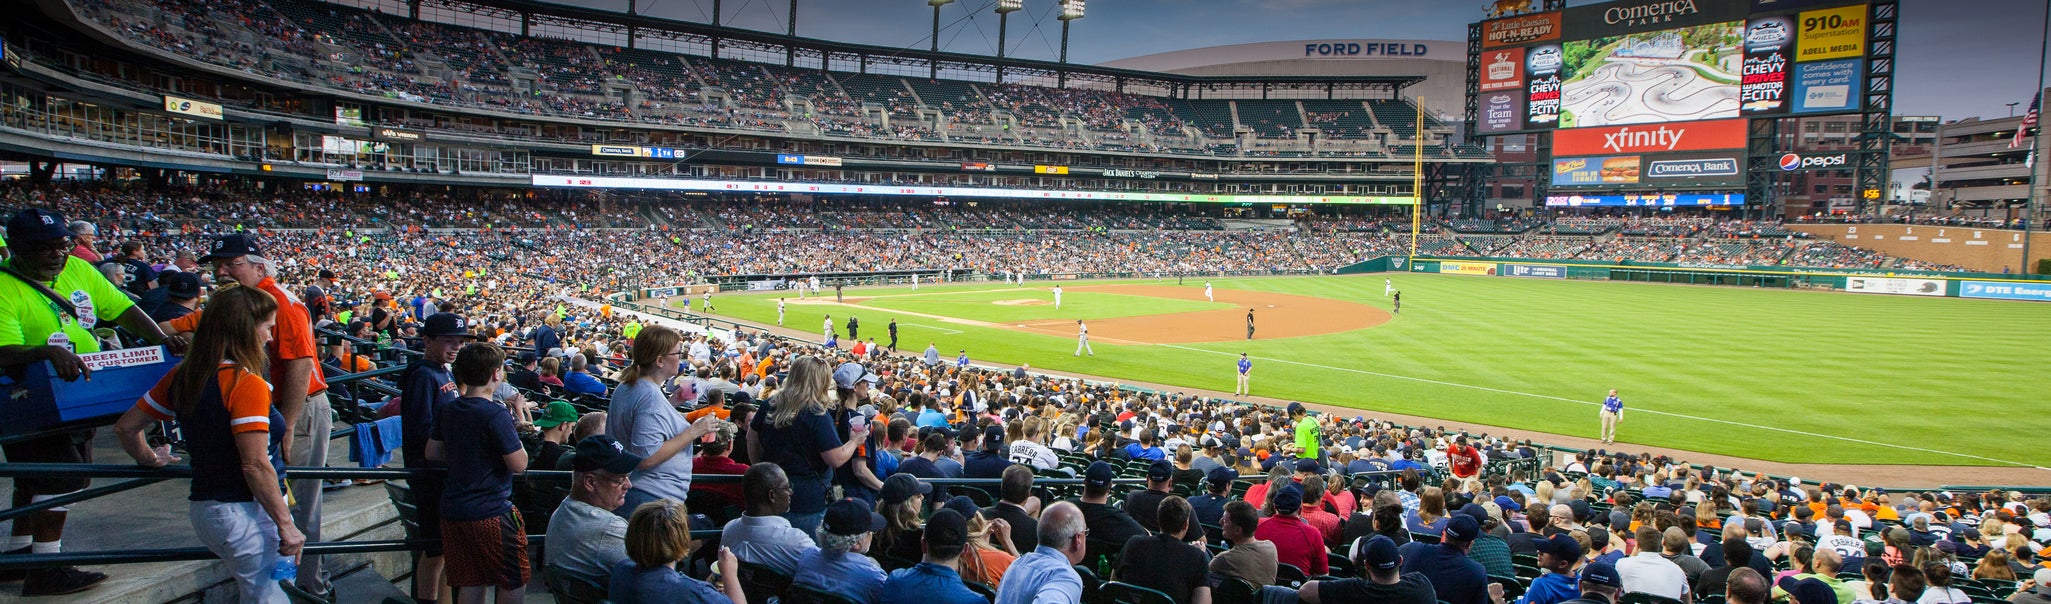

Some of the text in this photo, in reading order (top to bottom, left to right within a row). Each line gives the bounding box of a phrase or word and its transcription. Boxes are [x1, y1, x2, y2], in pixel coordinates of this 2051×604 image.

[1629, 14, 1672, 27] PARK
[1488, 25, 1553, 41] HOT-N-READY
[1803, 28, 1860, 40] Superstation
[1305, 42, 1428, 56] FORD FIELD
[1802, 43, 1858, 56] ADELL MEDIA
[1743, 62, 1785, 76] CHEVY
[1802, 68, 1853, 79] comes with
[1803, 62, 1854, 72] Confidence
[1743, 71, 1786, 84] DRIVES
[1801, 75, 1850, 86] every card.
[1531, 83, 1560, 94] CHEVY
[1752, 81, 1783, 90] MOTOR
[1530, 91, 1560, 102] DRIVES
[1741, 84, 1752, 102] THE
[1751, 88, 1783, 101] CITY
[1487, 109, 1512, 119] Team
[1537, 105, 1559, 115] CITY
[1603, 125, 1685, 153] xfinity
[1703, 161, 1730, 171] Bank
[1801, 153, 1847, 169] pepsi
[1985, 285, 2012, 296] DTE
[83, 349, 158, 363] BEER LIMIT
[98, 355, 159, 367] CUSTOMER
[1011, 445, 1038, 459] CABRERA
[1830, 538, 1865, 551] CABRERA
